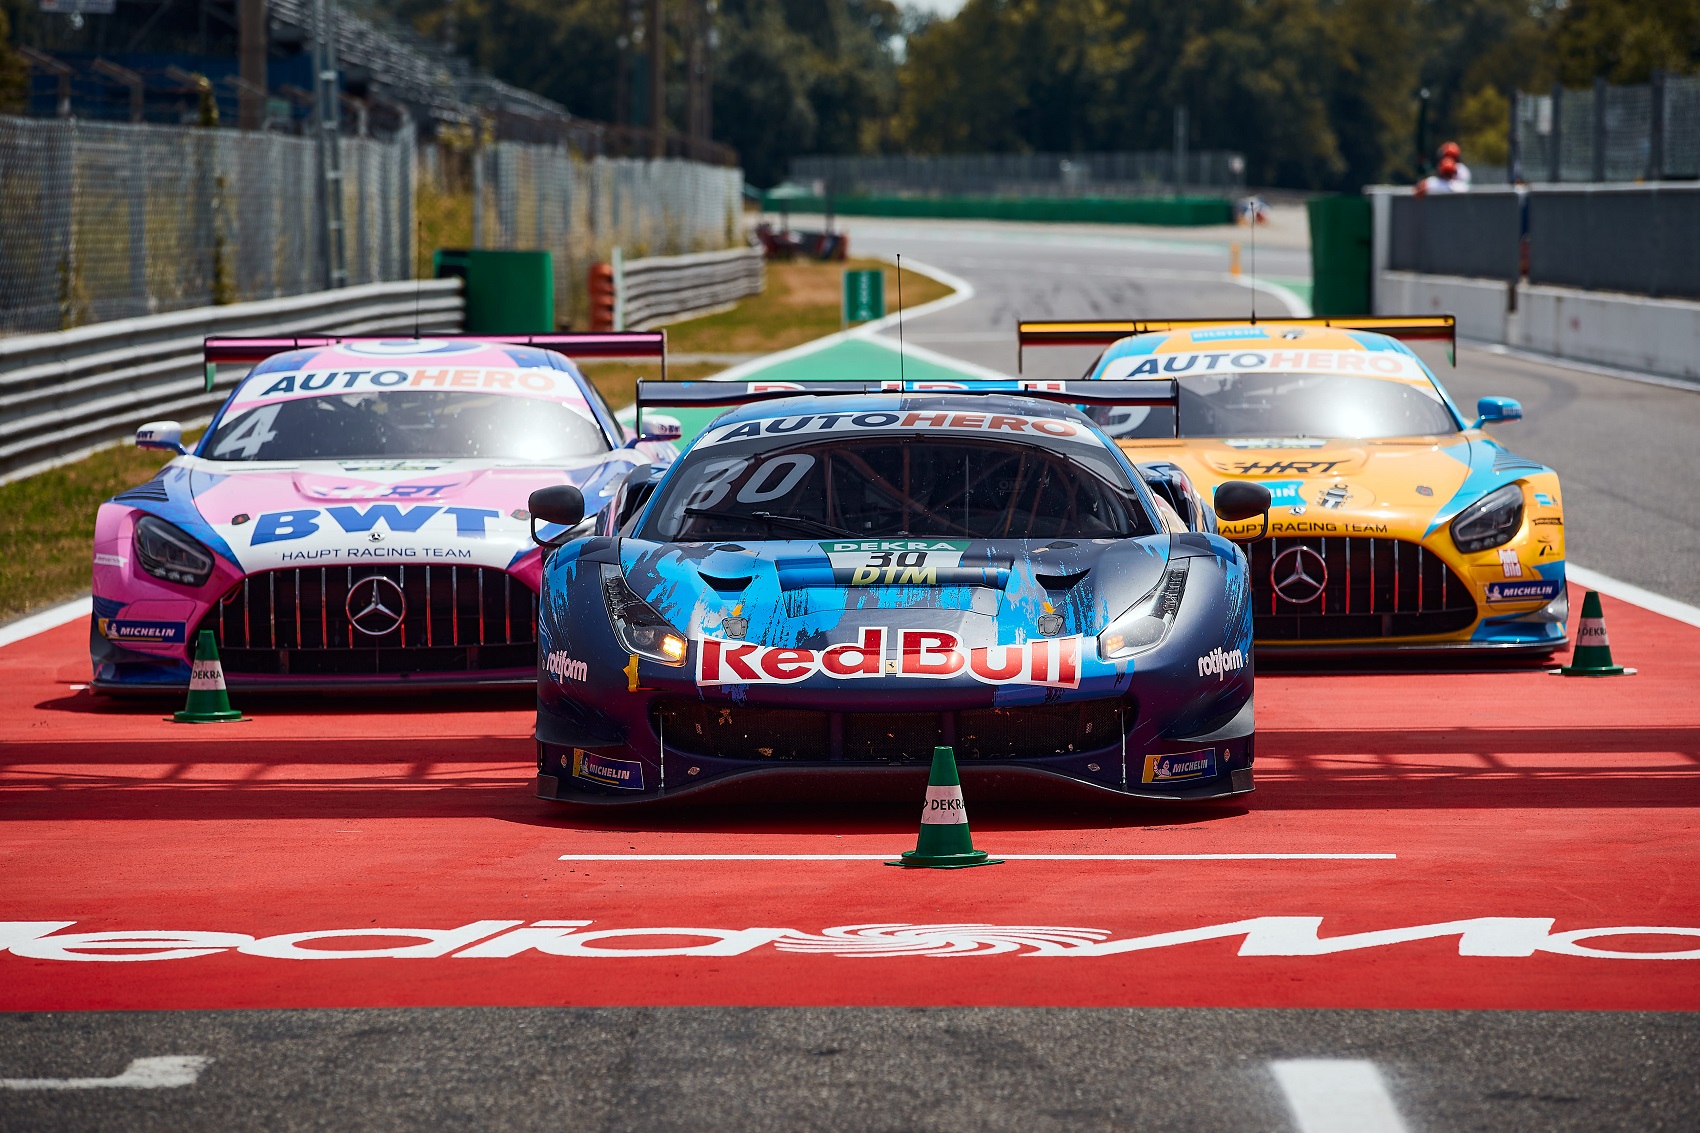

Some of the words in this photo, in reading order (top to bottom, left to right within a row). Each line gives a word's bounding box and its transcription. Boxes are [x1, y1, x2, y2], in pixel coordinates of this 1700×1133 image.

[1127, 352, 1404, 377] AUTOHERO
[260, 369, 556, 396] AUTOHERO
[213, 403, 284, 458] 4
[716, 412, 1078, 443] AUTOHERO
[684, 453, 816, 510] 30
[250, 504, 500, 546] BWT
[1272, 522, 1338, 532] RACING
[1344, 523, 1388, 533] TEAM
[281, 549, 342, 561] HAUPT
[347, 547, 417, 557] RACING
[424, 548, 472, 558] TEAM
[833, 542, 957, 551] DEKRA
[866, 551, 929, 568] 30
[852, 567, 937, 585] DTM
[1503, 586, 1553, 597] MICHELIN
[120, 626, 176, 637] MICHELIN
[700, 628, 884, 683] Red
[900, 630, 1080, 686] Bull
[1198, 647, 1243, 681] rotiform
[192, 669, 222, 680] DEKRA
[546, 650, 588, 684] rotiform
[589, 763, 630, 780] MICHELIN
[1172, 759, 1208, 774] MICHELIN
